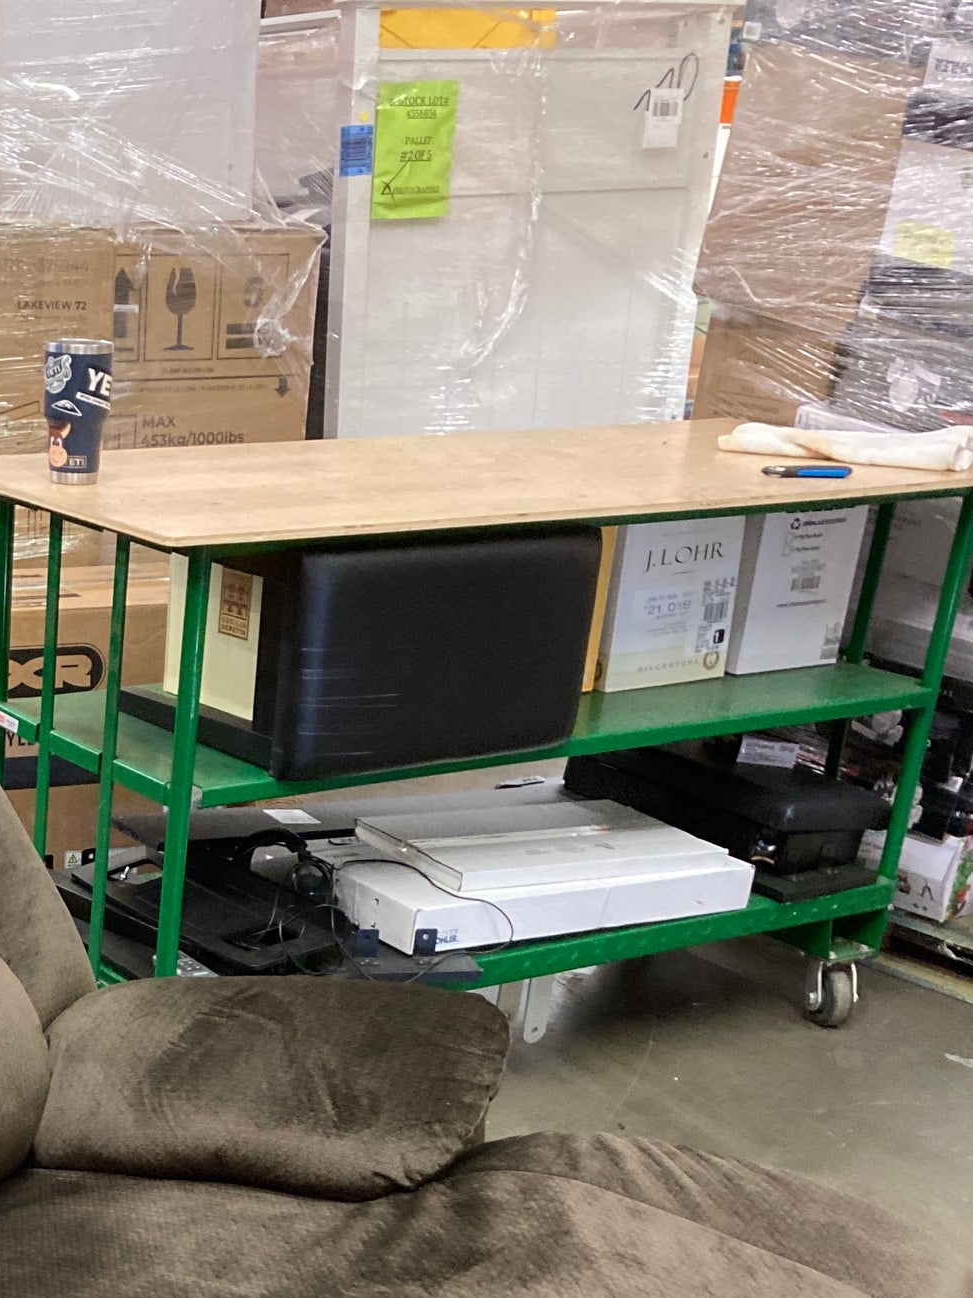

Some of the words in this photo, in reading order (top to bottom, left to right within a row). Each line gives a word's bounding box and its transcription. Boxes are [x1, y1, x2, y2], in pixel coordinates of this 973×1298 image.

[404, 136, 433, 145] PALLET
[17, 300, 72, 311] LAKEVIEW
[74, 300, 87, 311] 72
[142, 415, 176, 428] MAX
[141, 430, 244, 447] 453kg/1000lbs
[660, 541, 726, 566] LOHR
